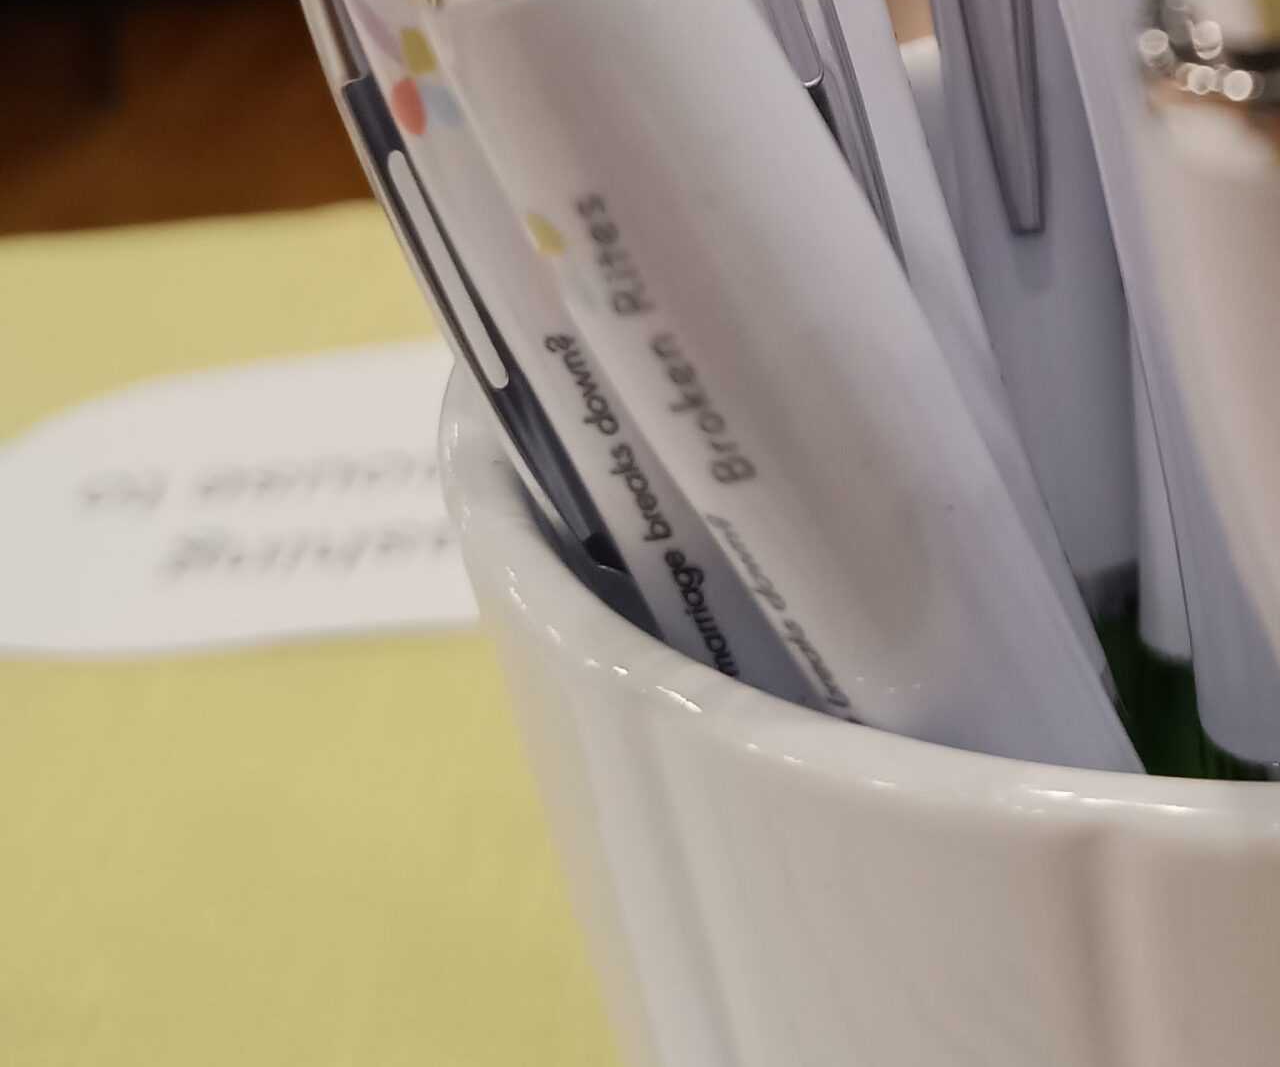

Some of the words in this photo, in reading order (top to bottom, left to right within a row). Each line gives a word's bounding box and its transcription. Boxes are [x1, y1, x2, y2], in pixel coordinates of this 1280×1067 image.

[544, 335, 620, 436] down?
[651, 332, 757, 484] Broken
[610, 444, 672, 542] breaks
